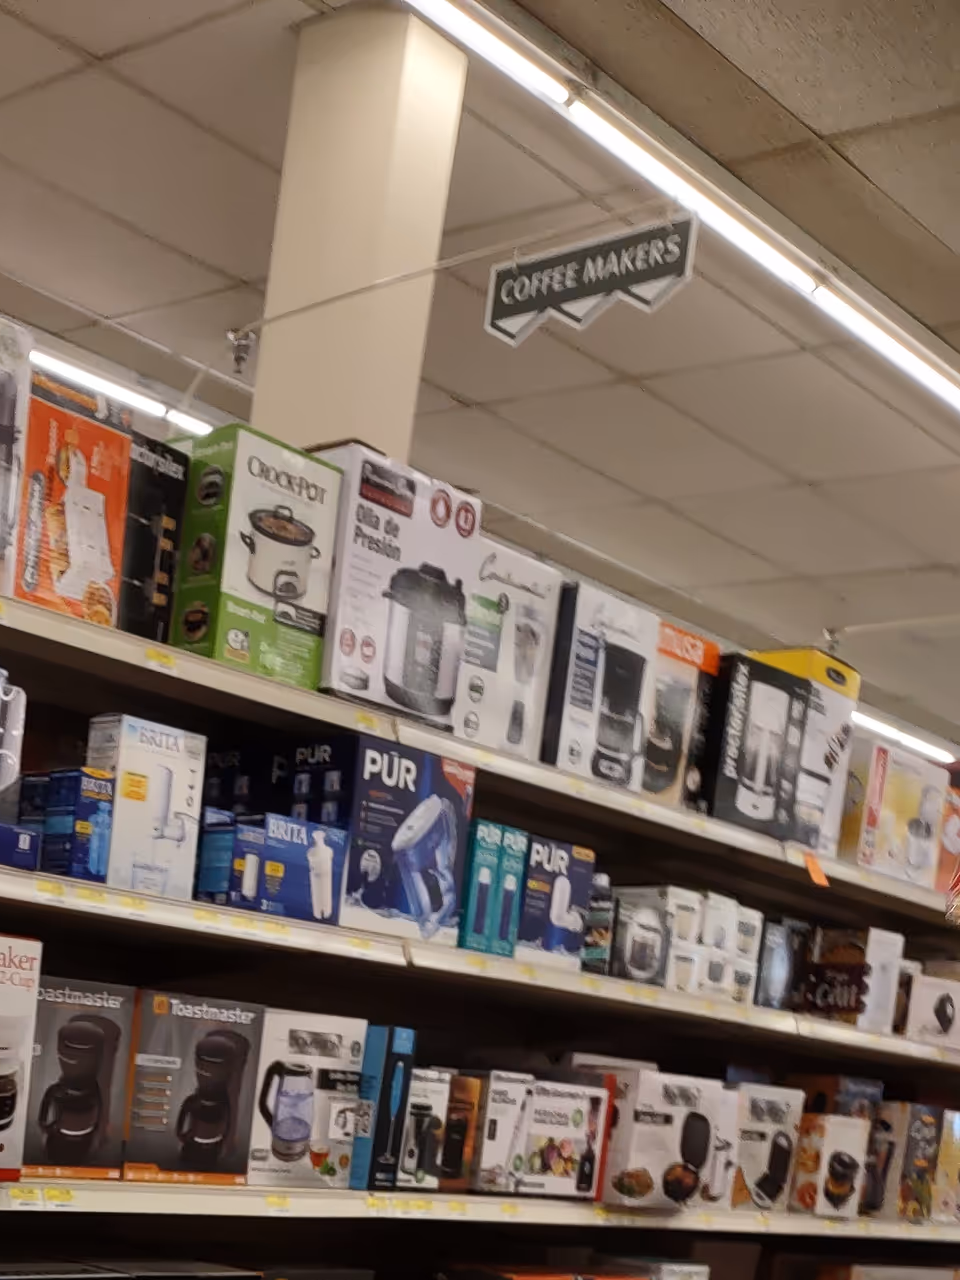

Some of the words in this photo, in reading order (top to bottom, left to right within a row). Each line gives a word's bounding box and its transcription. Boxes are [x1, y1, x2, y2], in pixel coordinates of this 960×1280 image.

[500, 261, 581, 305] COFFEE
[582, 233, 682, 284] MAKERS
[383, 516, 401, 538] de
[267, 817, 309, 846] BRITA
[36, 984, 123, 1009] oastmaster
[170, 998, 257, 1025] Toastmaster
